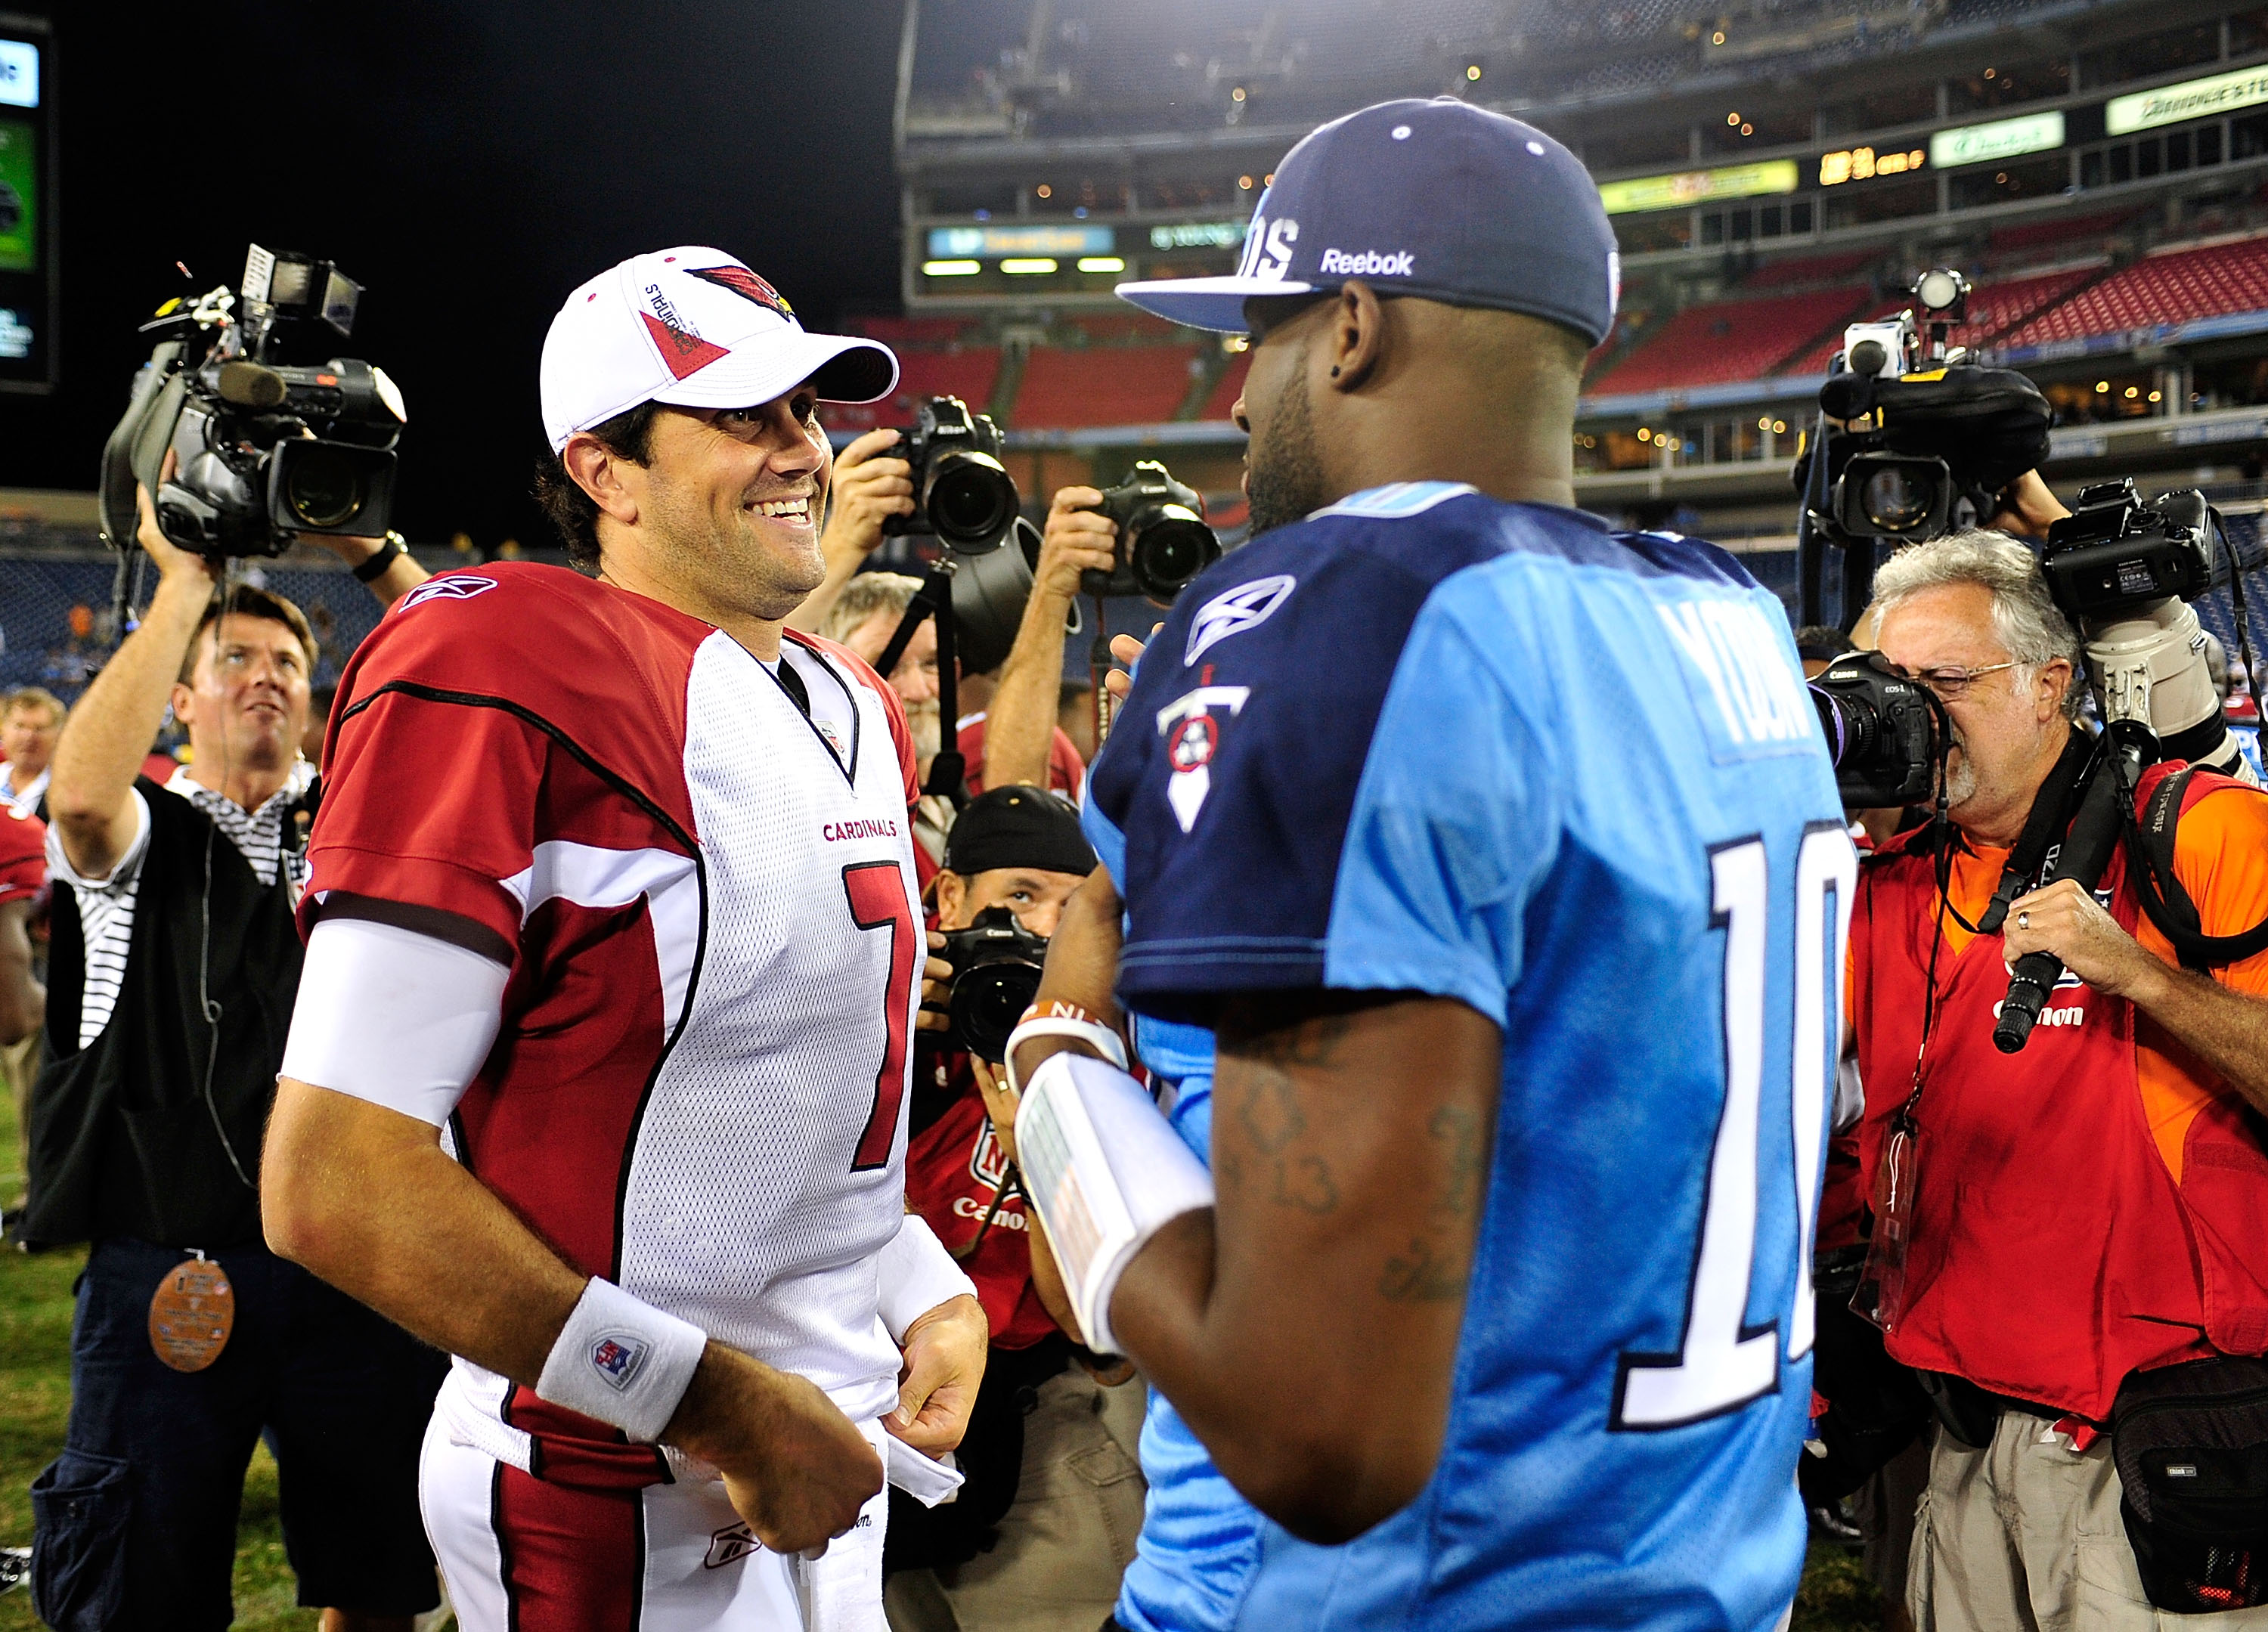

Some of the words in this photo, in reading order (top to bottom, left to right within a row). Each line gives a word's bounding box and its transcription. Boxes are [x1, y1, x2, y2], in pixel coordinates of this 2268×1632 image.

[1320, 247, 1415, 277] Reebok
[645, 283, 693, 356] CARDINALS
[1830, 670, 1857, 680] Canon
[823, 819, 897, 842] CARDINALS
[841, 859, 916, 1172] 7
[1606, 819, 1858, 1432] 10
[953, 1197, 1030, 1232] Cano
